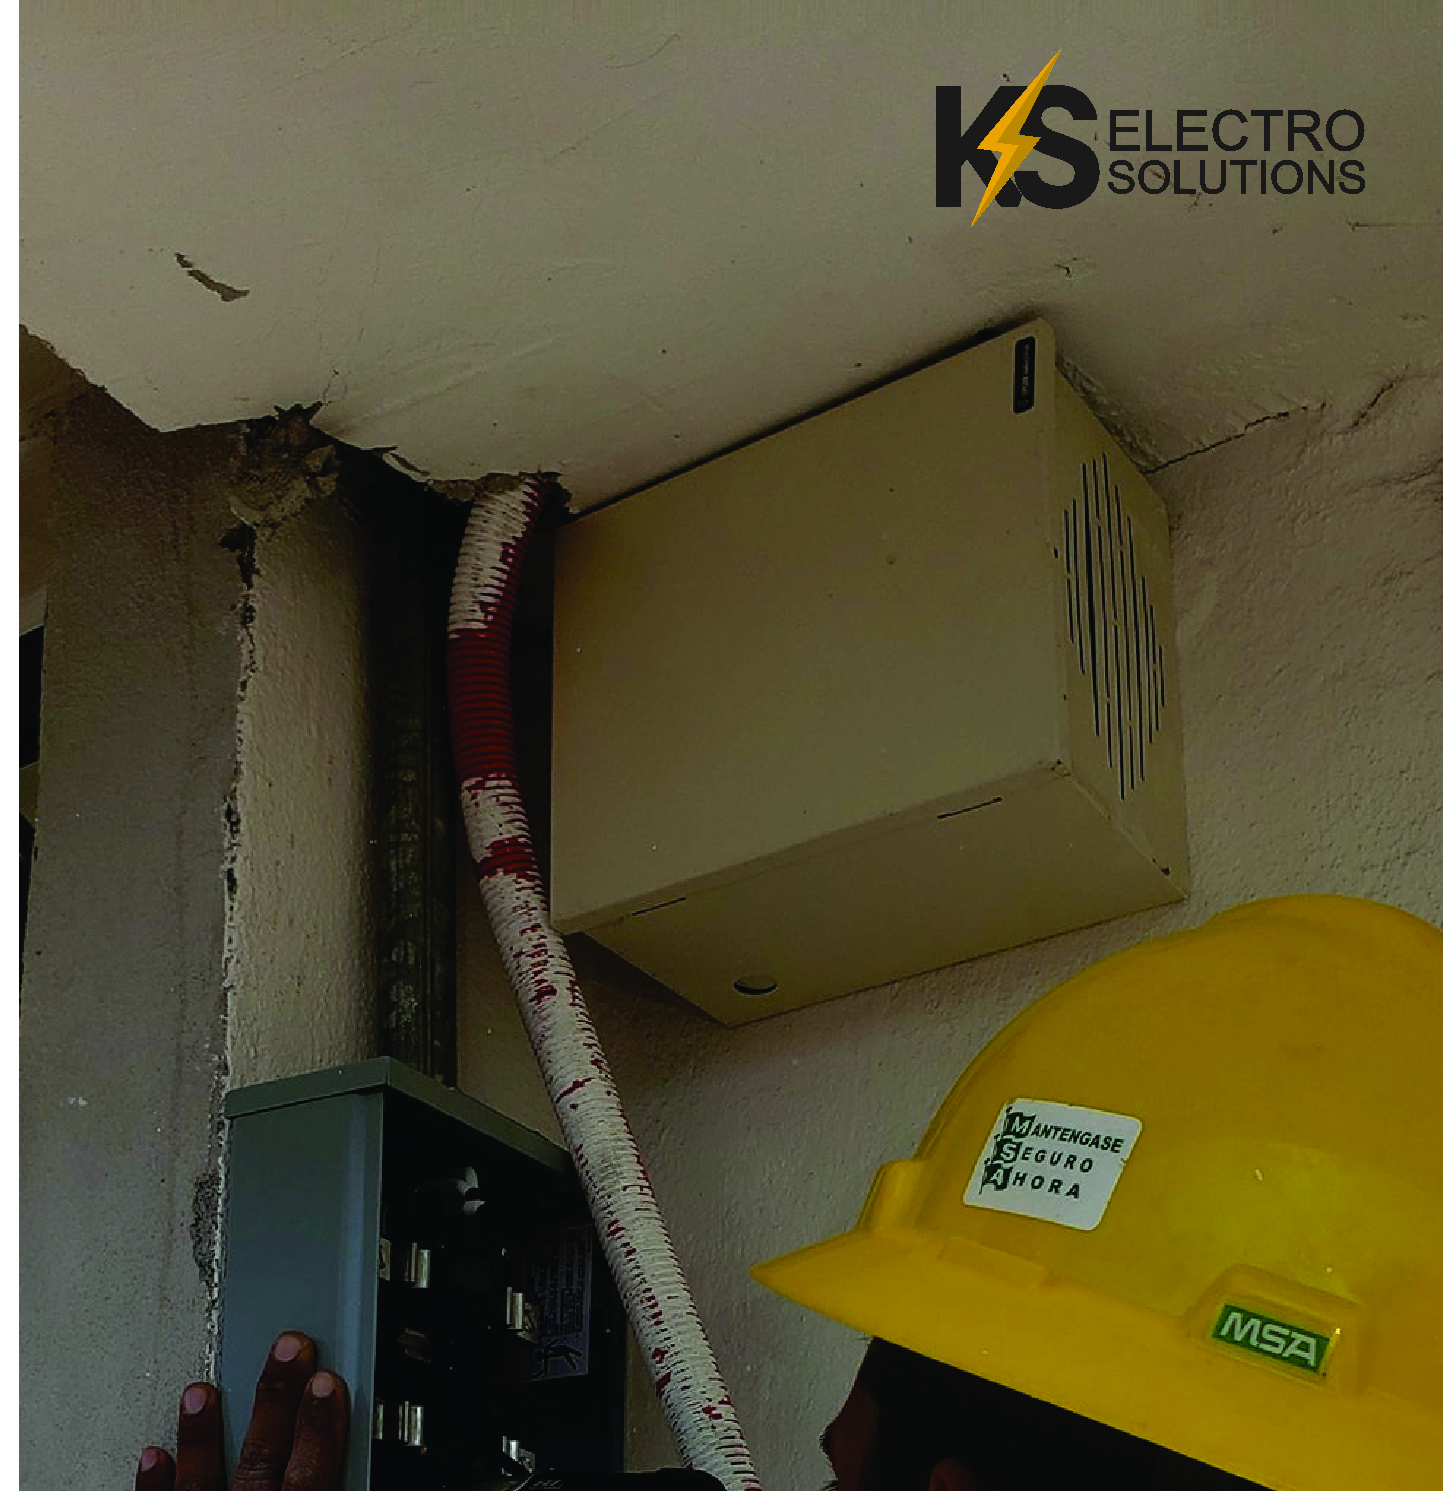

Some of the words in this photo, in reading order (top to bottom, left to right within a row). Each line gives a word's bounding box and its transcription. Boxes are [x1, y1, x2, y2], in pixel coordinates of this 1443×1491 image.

[998, 1139, 1094, 1174] SEGURO
[987, 1166, 1080, 1200] AHORA
[1220, 1311, 1317, 1367] MSA
